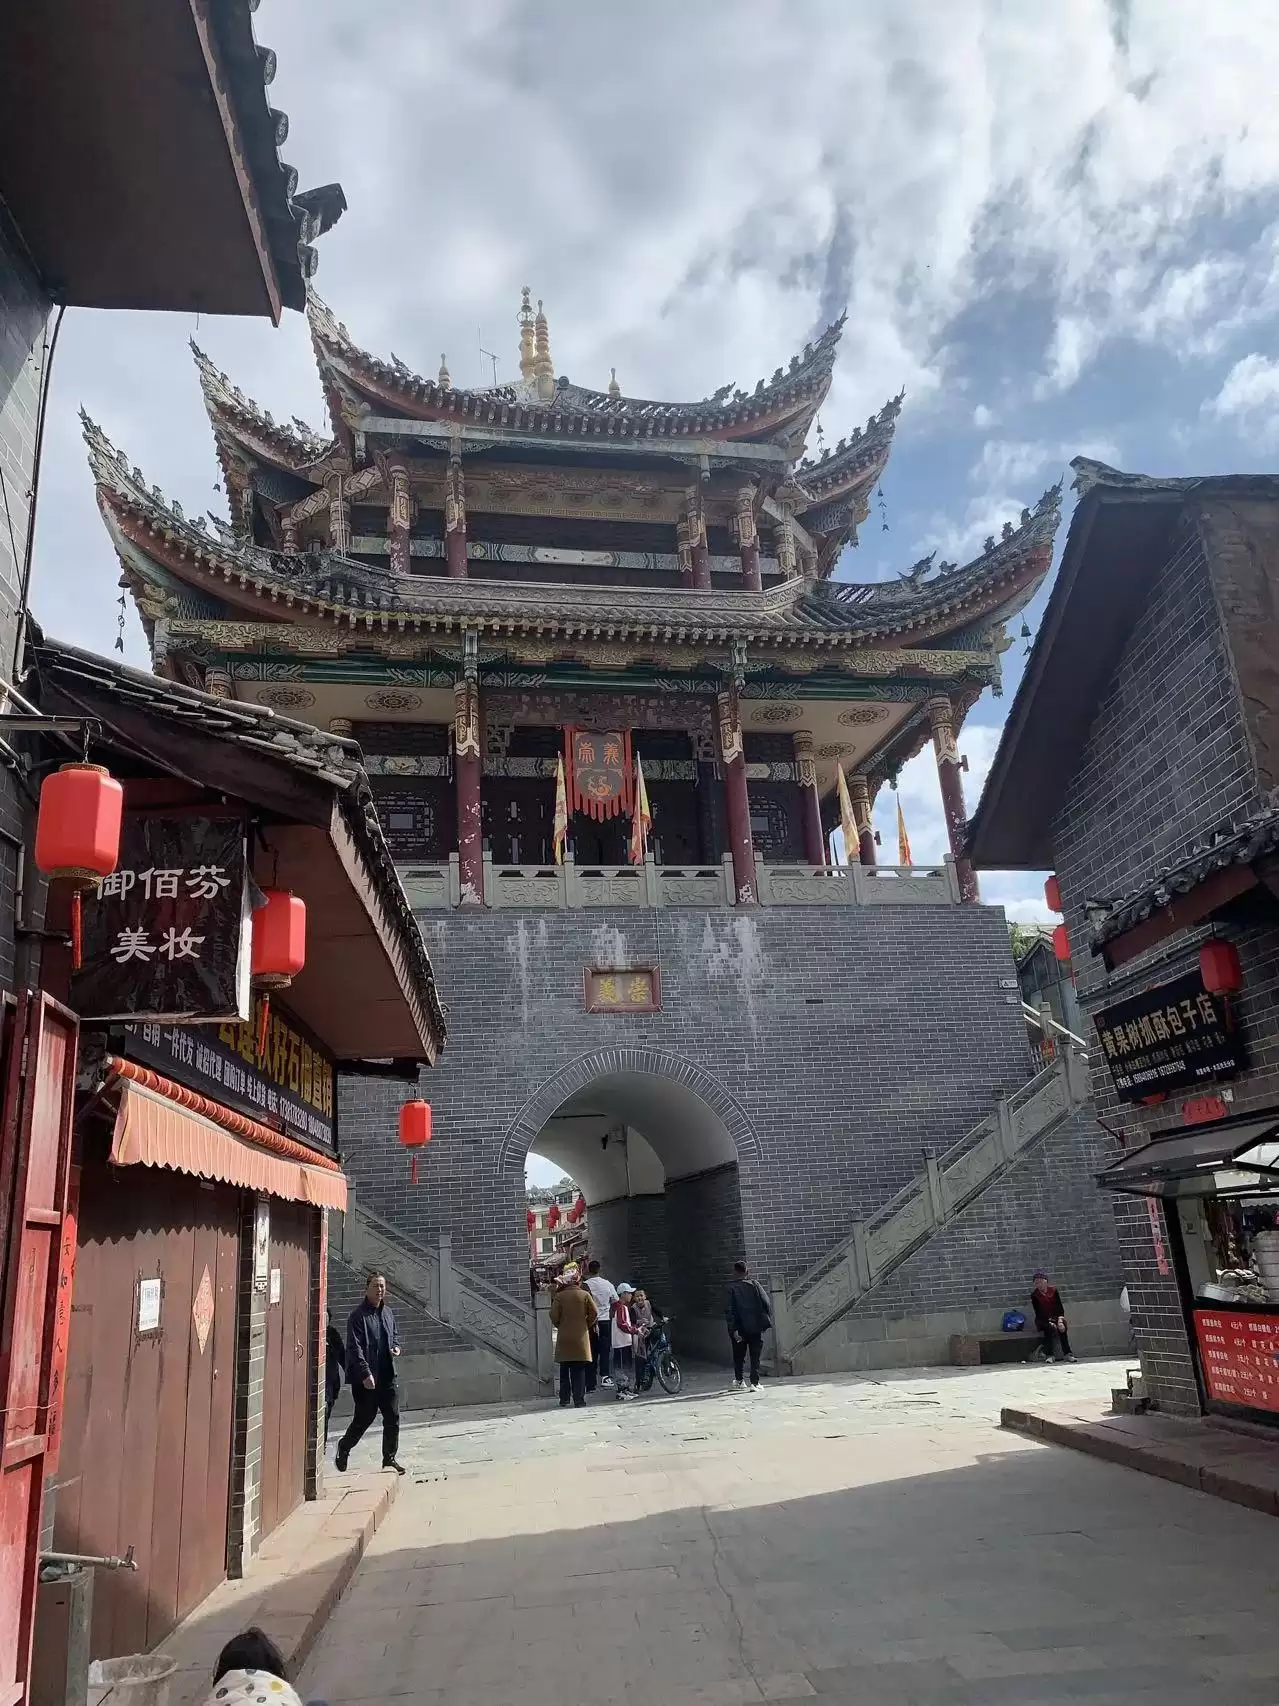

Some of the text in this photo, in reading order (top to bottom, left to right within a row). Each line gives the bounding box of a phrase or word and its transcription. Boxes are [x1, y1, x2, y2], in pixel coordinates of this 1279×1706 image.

[97, 865, 231, 900] 御佰芬
[110, 926, 206, 963] 美妆
[1102, 992, 1218, 1059] 黄果树抓酥包子店
